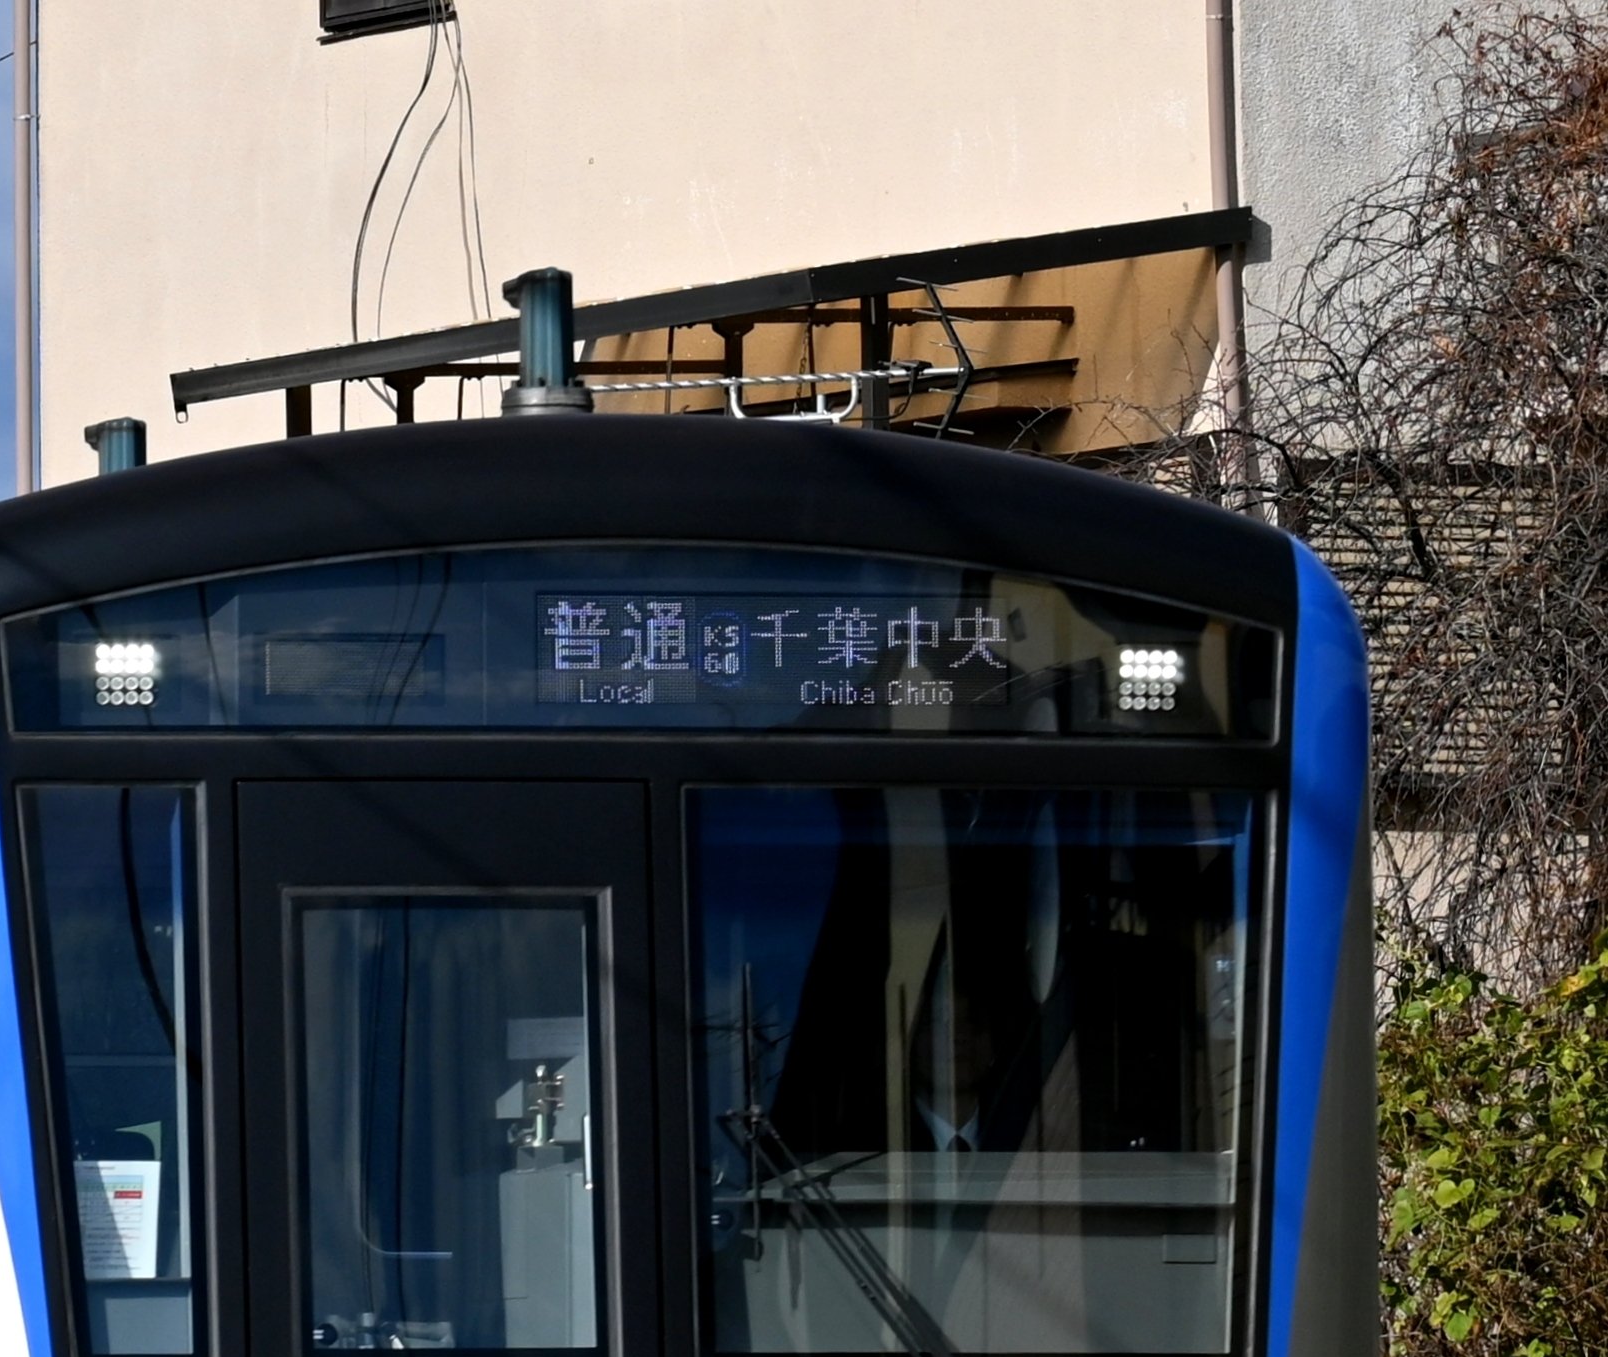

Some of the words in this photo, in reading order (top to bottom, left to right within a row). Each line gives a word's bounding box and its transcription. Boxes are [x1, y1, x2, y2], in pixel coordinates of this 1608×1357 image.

[544, 601, 690, 670] 普通
[703, 625, 740, 648] KS
[750, 606, 1008, 668] 千葉中央
[579, 677, 654, 704] Local
[800, 680, 875, 705] Chiba
